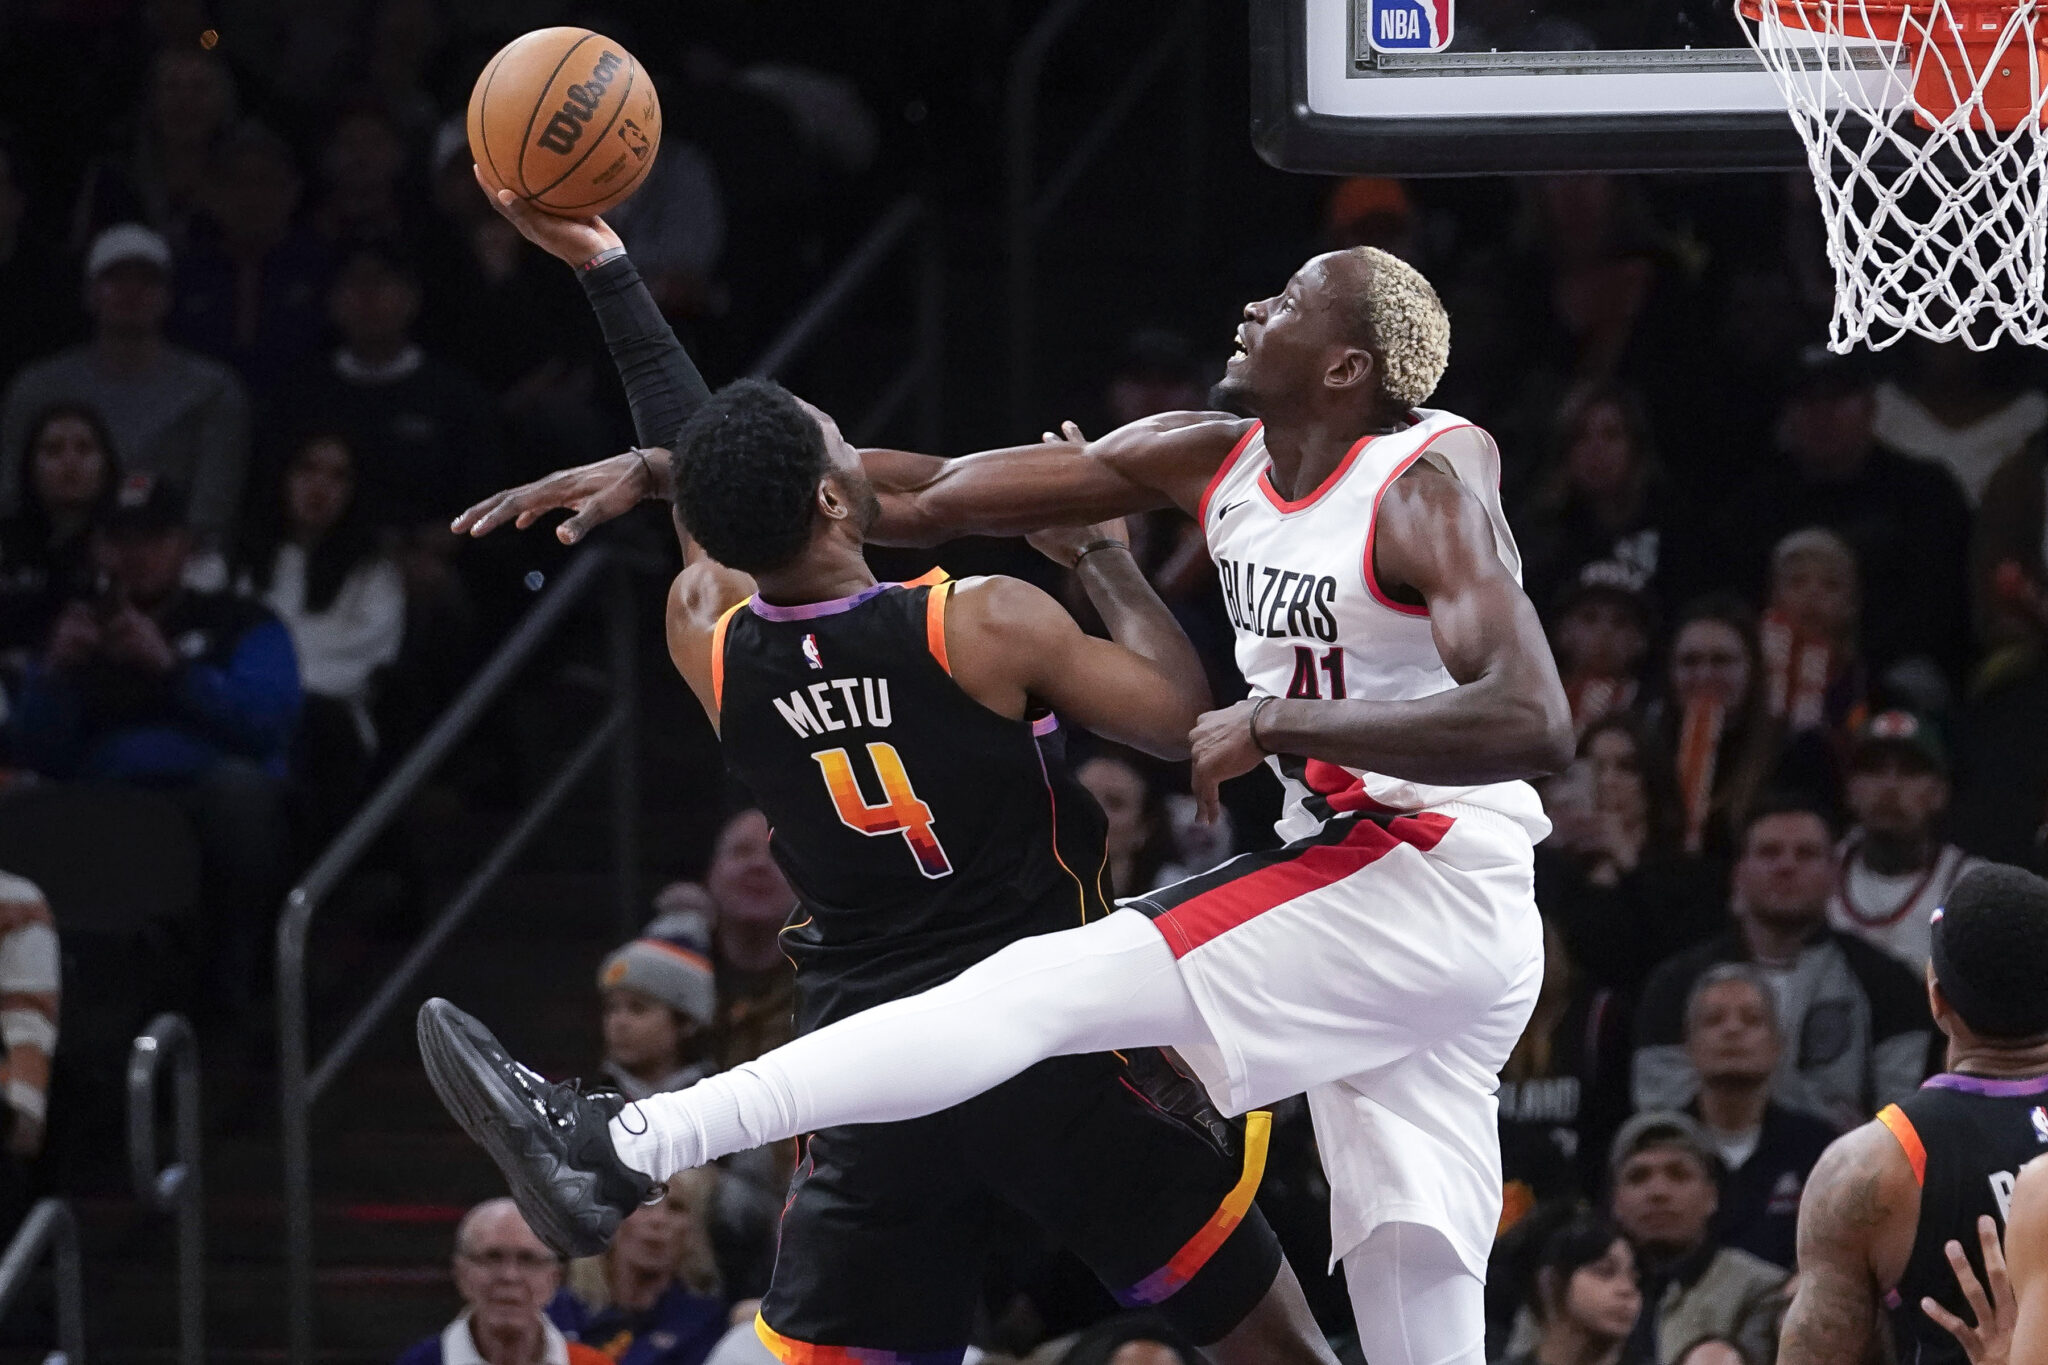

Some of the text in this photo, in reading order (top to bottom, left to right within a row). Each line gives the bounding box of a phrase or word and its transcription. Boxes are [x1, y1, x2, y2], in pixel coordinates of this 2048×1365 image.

[1380, 9, 1420, 40] NBA
[536, 50, 623, 156] Wilson
[1219, 557, 1338, 643] BLAZERS
[772, 677, 893, 739] METU
[1286, 645, 1347, 700] 41
[811, 741, 954, 880] 4
